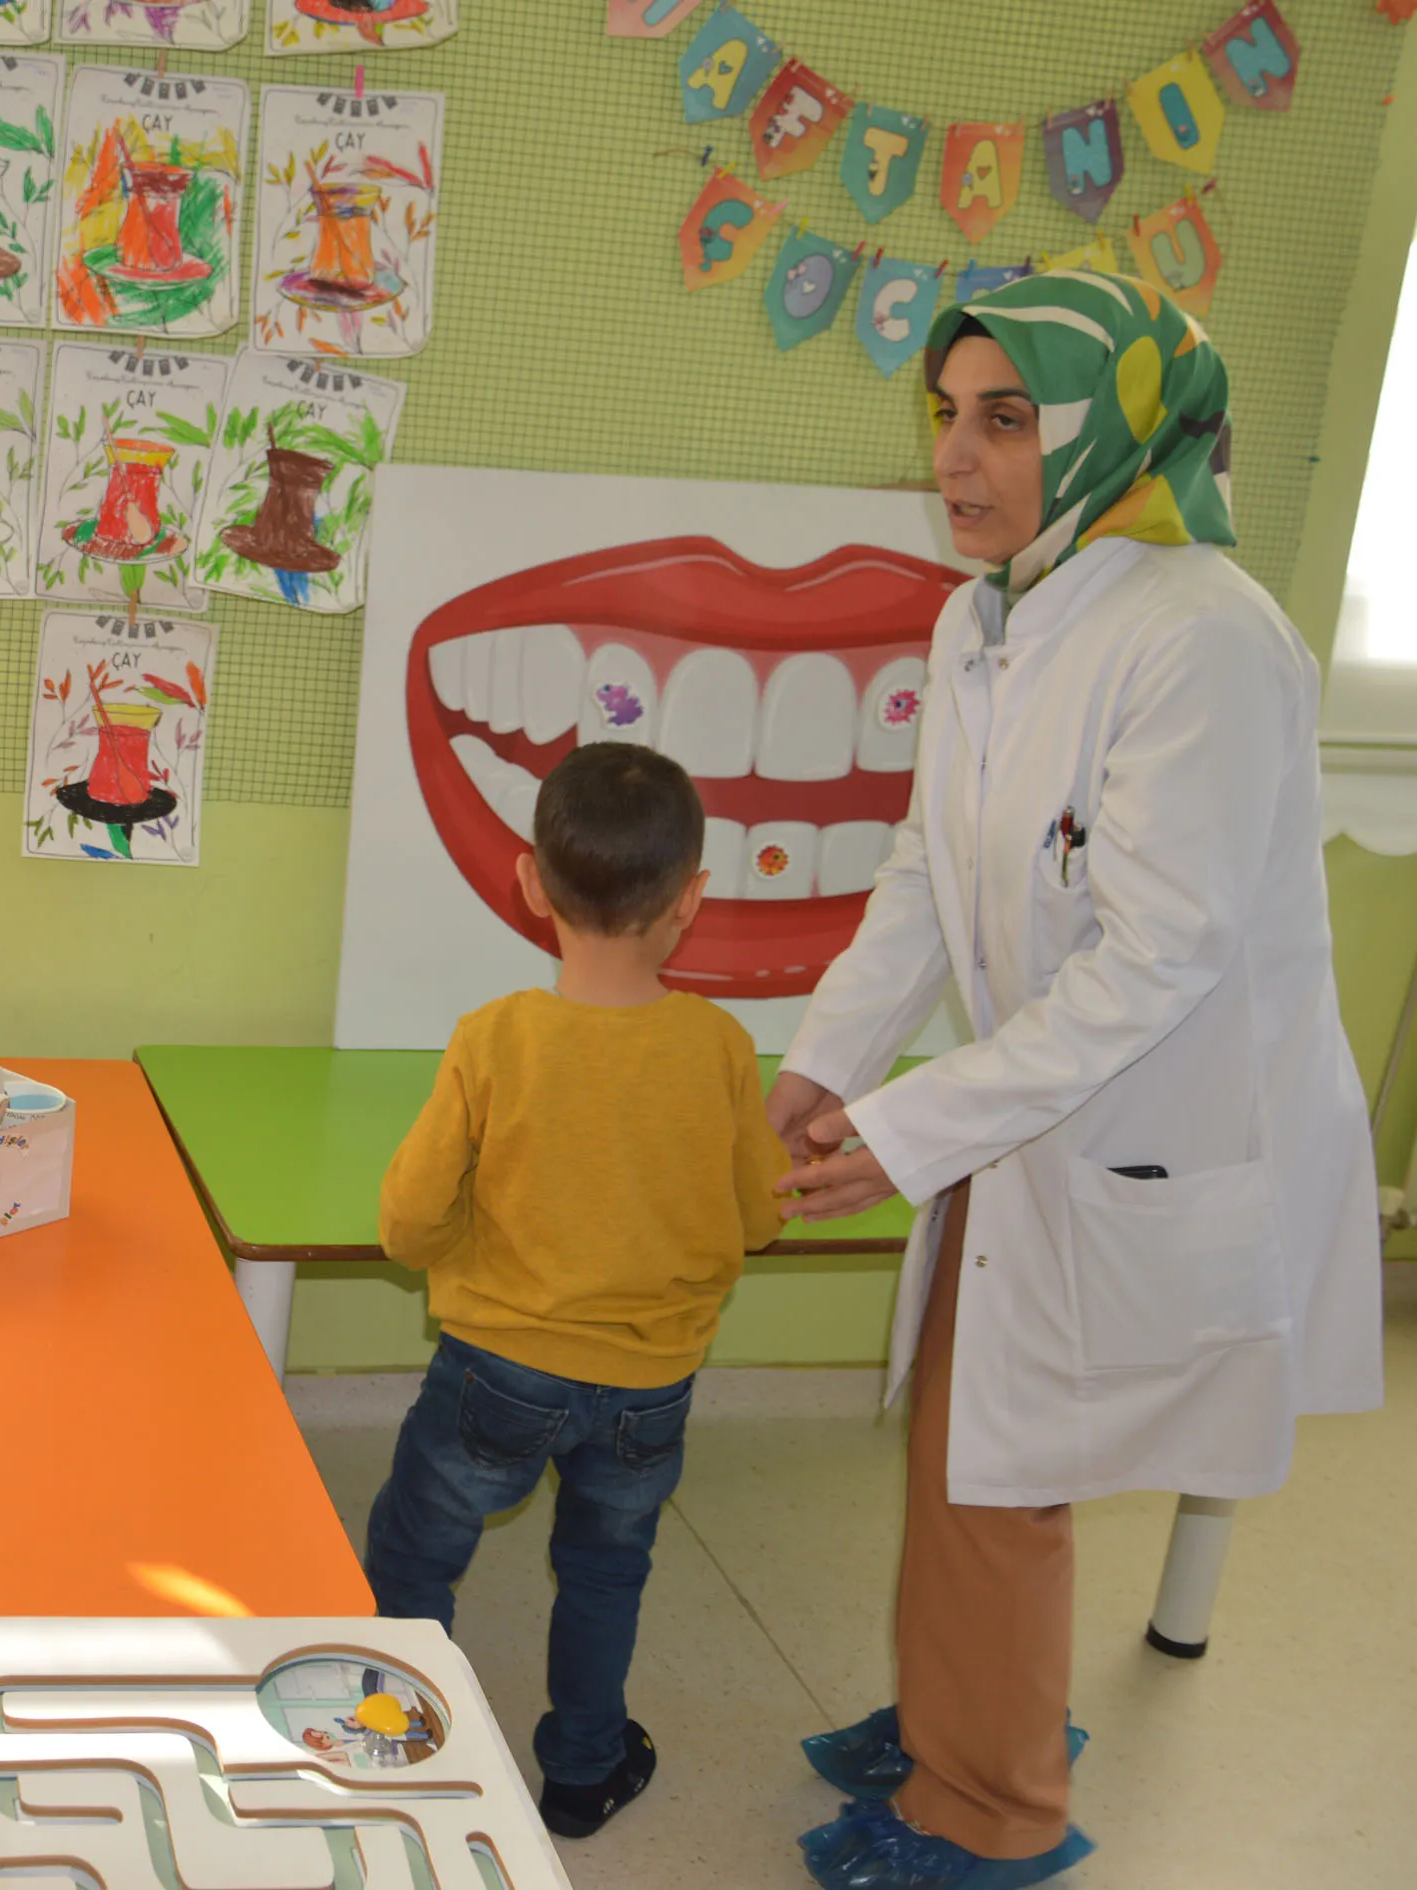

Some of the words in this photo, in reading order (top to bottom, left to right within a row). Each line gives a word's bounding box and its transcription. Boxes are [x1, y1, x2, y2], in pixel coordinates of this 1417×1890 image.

[642, 0, 1292, 210] AFTANIN
[142, 114, 173, 133] ÇAY
[335, 132, 365, 152] ÇAY
[699, 199, 1205, 342] ÇOCU
[126, 390, 156, 409] ÇAY
[297, 400, 327, 421] ÇAY
[112, 652, 141, 671] ÇAY
